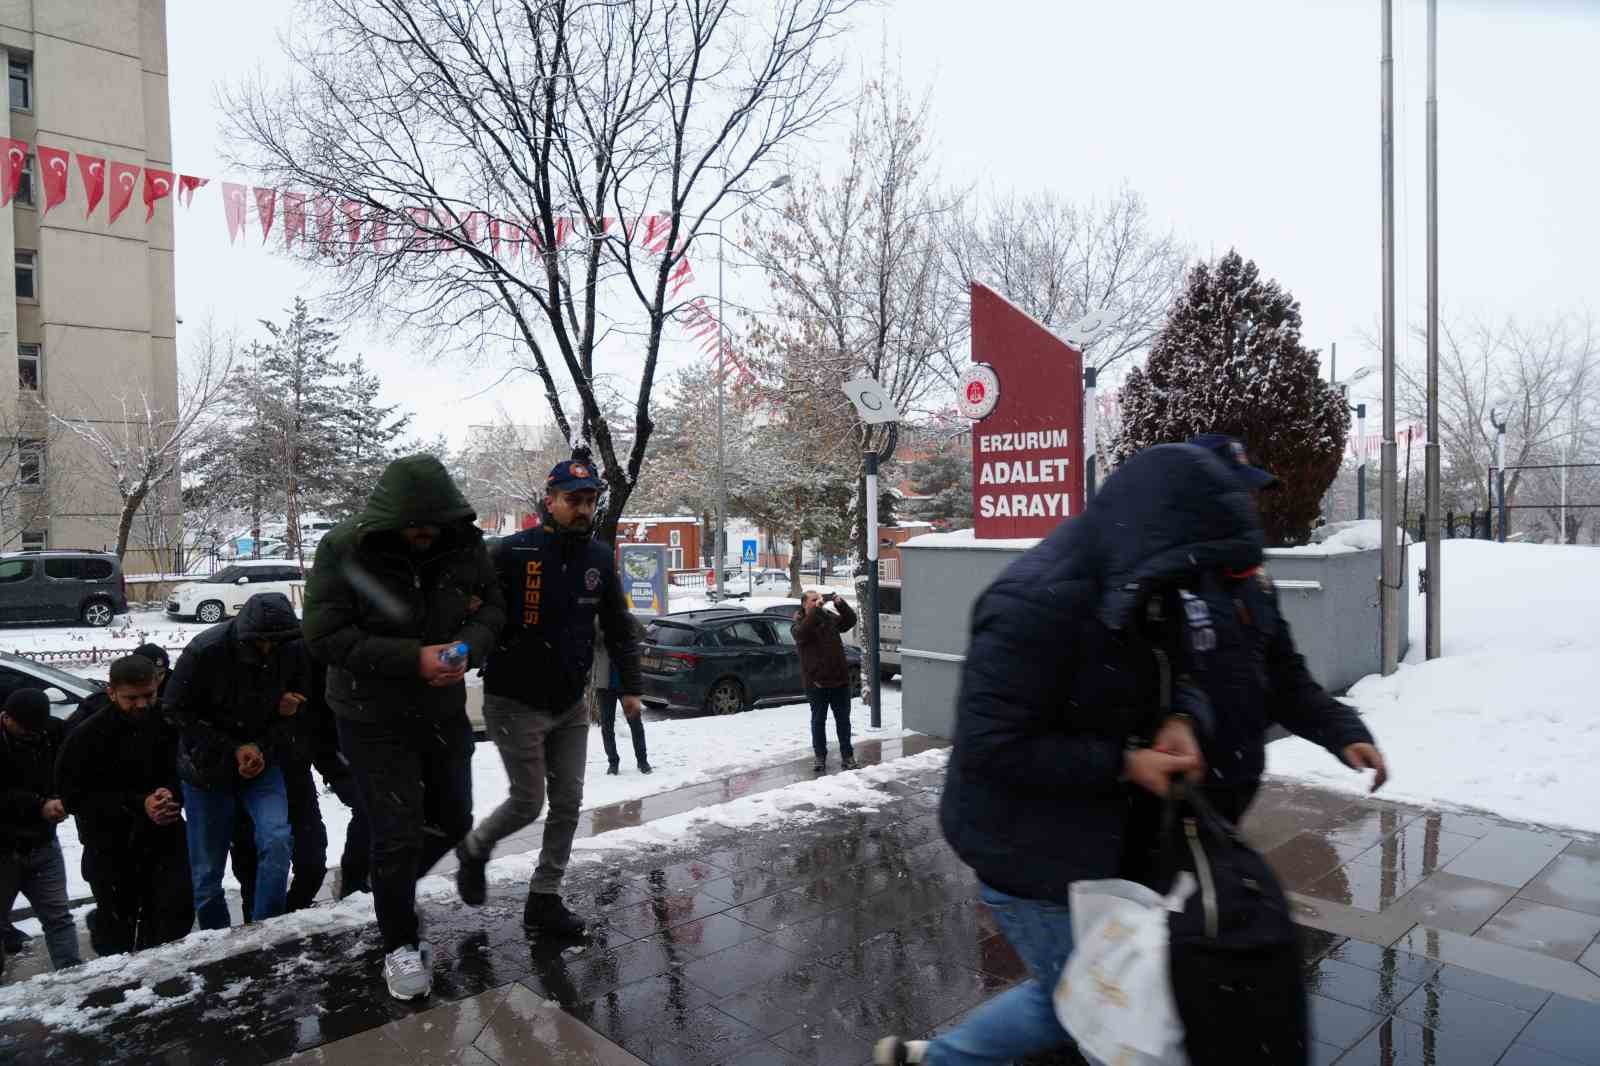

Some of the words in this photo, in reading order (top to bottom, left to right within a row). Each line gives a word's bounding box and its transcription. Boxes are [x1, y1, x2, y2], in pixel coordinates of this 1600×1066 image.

[980, 428, 1068, 453] ERZURUM
[979, 458, 1069, 485] ADALET
[980, 493, 1070, 518] SARAYI
